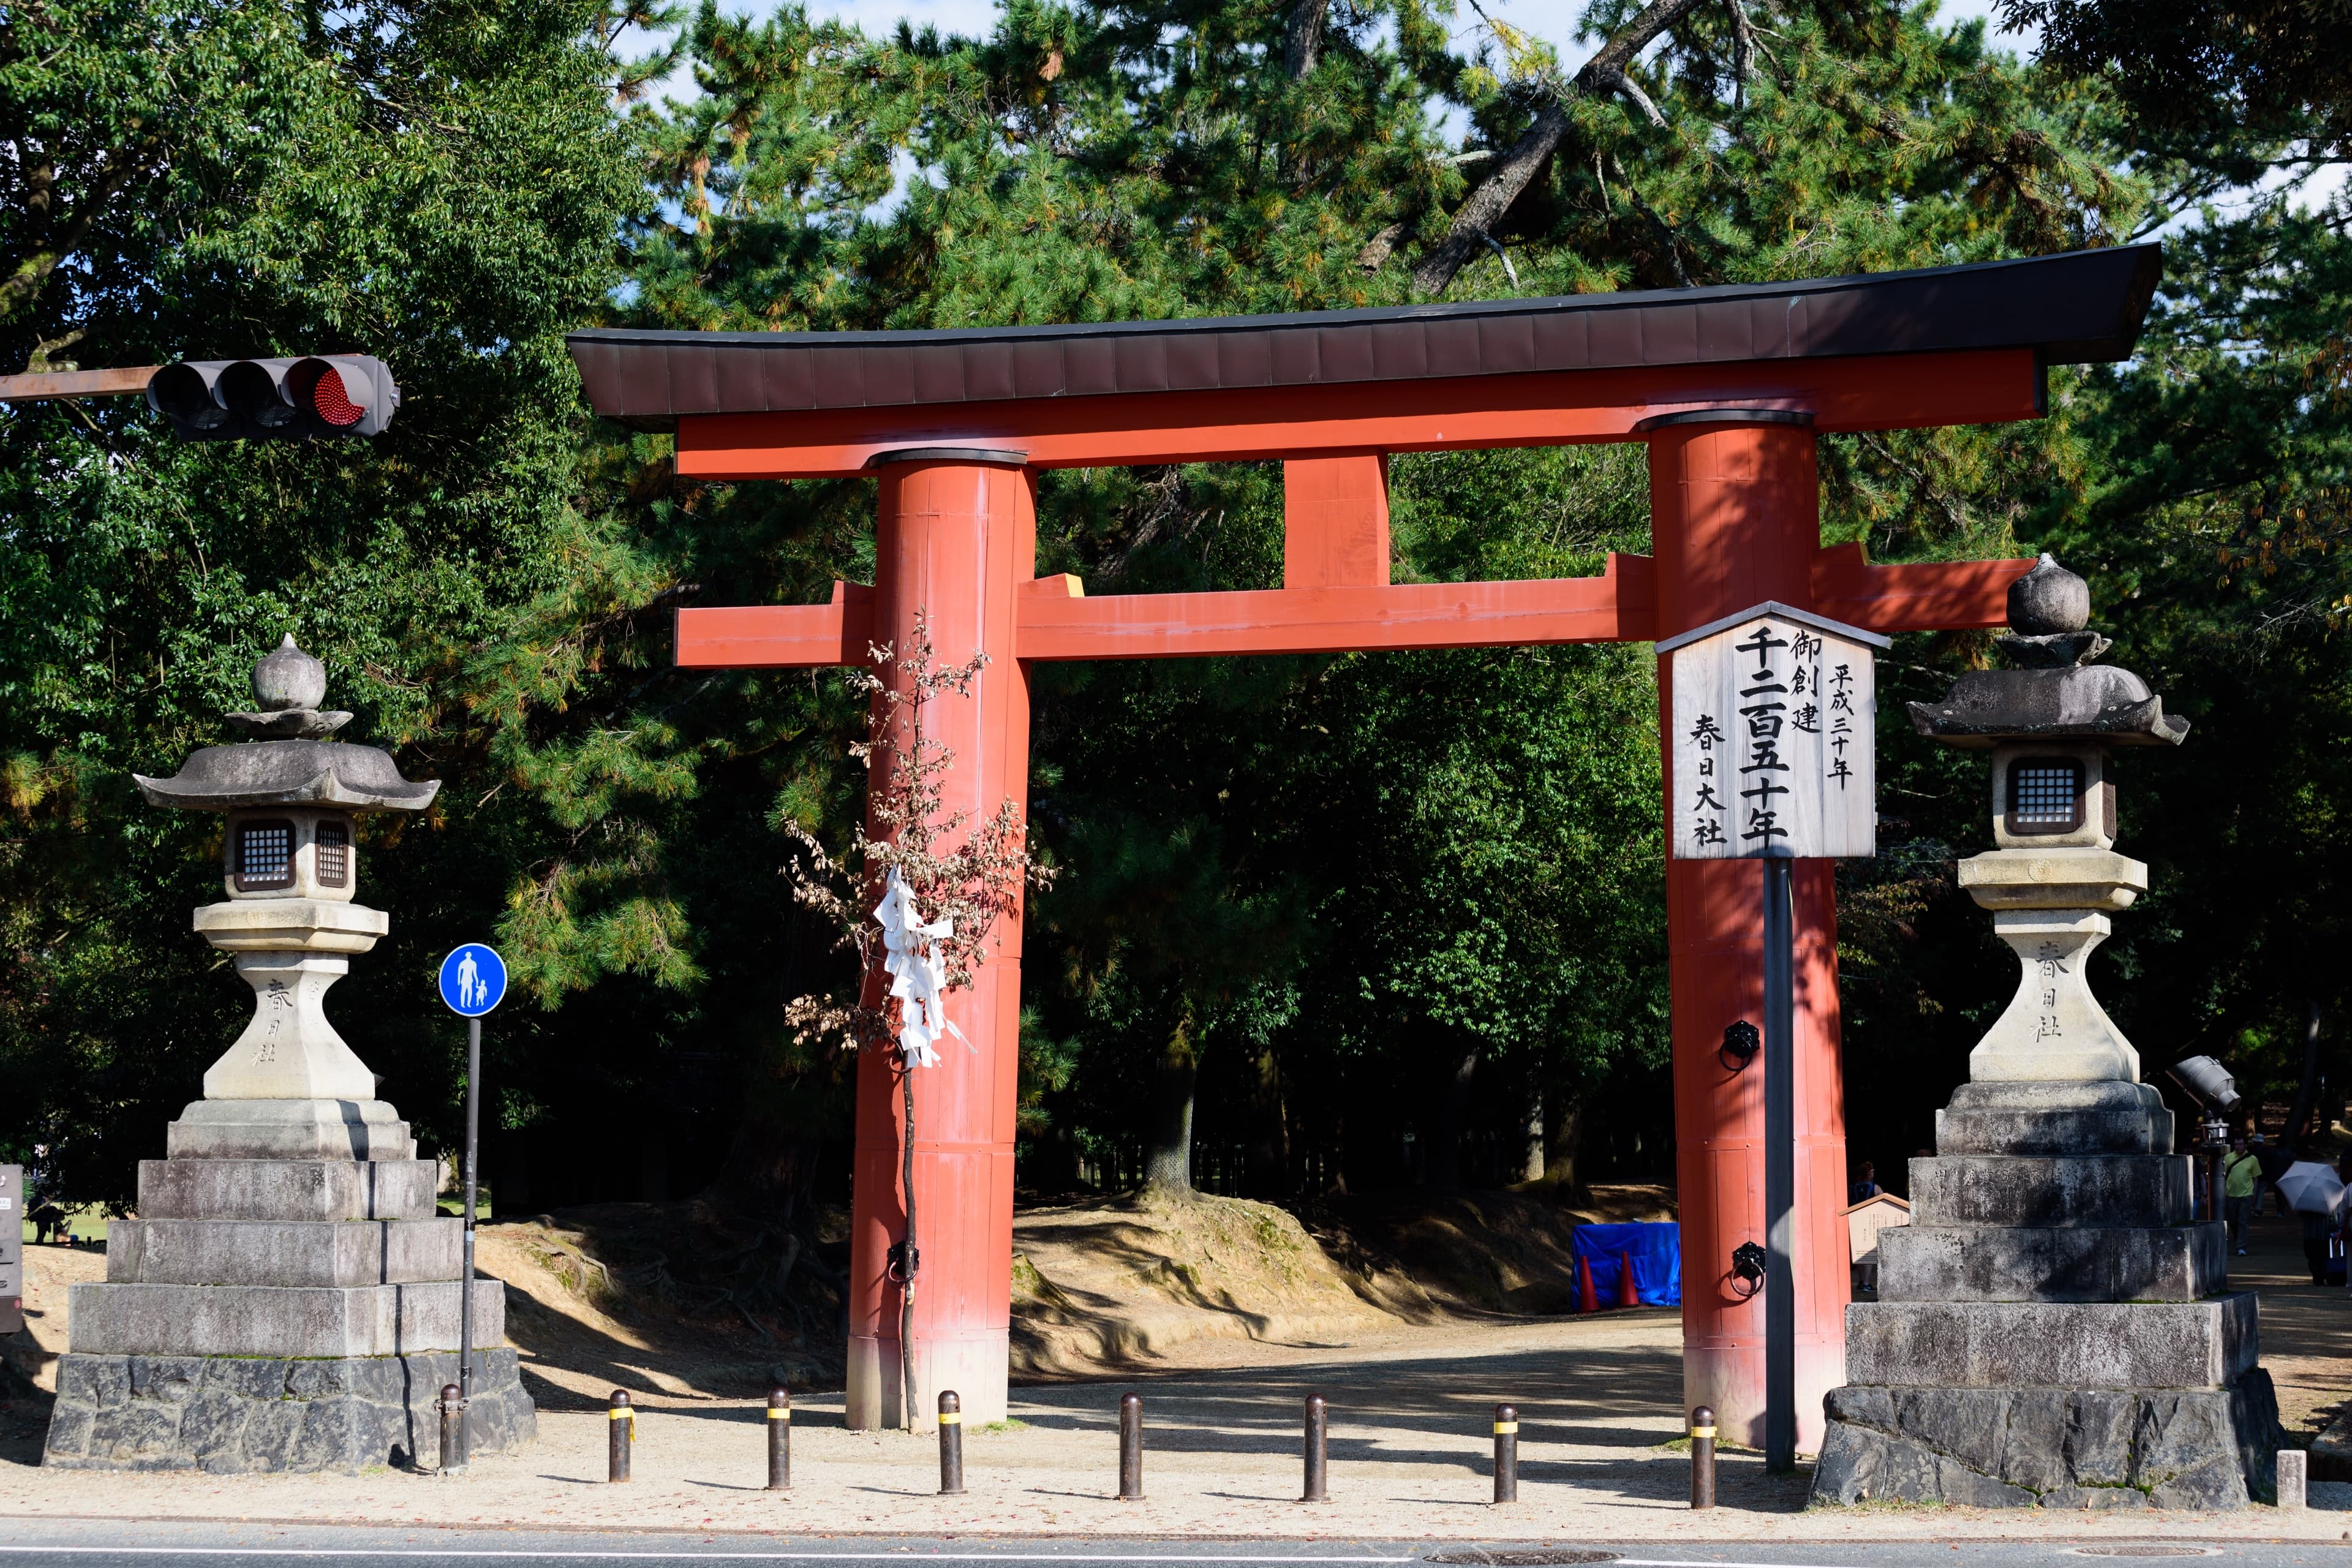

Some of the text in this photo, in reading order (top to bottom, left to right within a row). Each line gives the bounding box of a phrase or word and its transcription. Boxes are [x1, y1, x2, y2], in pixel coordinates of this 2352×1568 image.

[1735, 626, 1790, 851] 千二百五十年
[1789, 629, 1823, 734] 御創建
[1826, 663, 1855, 791] 平成三十年
[1686, 714, 1728, 847] 春日大社
[250, 978, 293, 1068] 春日社
[2029, 940, 2070, 1043] 春日社
